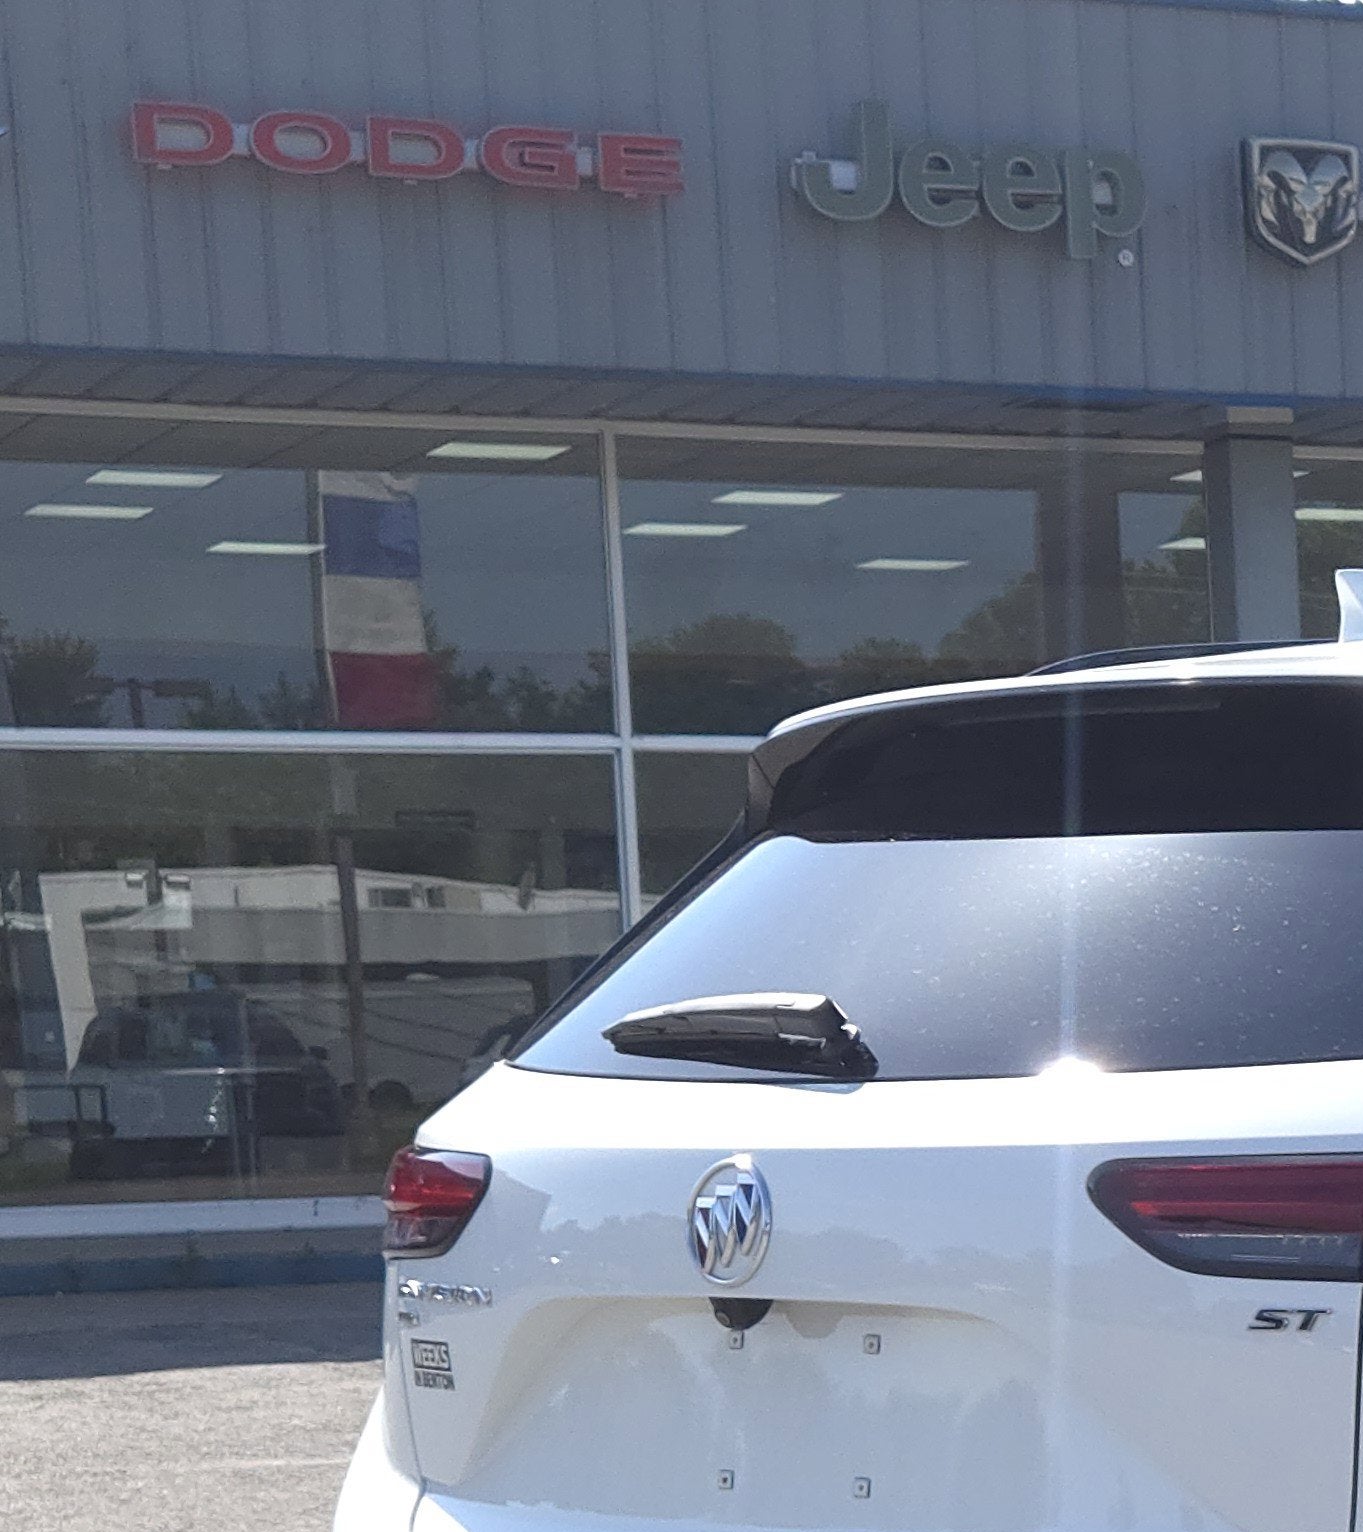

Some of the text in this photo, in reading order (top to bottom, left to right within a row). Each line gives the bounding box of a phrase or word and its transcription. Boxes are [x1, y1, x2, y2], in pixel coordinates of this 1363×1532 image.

[132, 102, 684, 196] DODGE
[799, 100, 1144, 259] Jeep
[1248, 1308, 1334, 1332] ST
